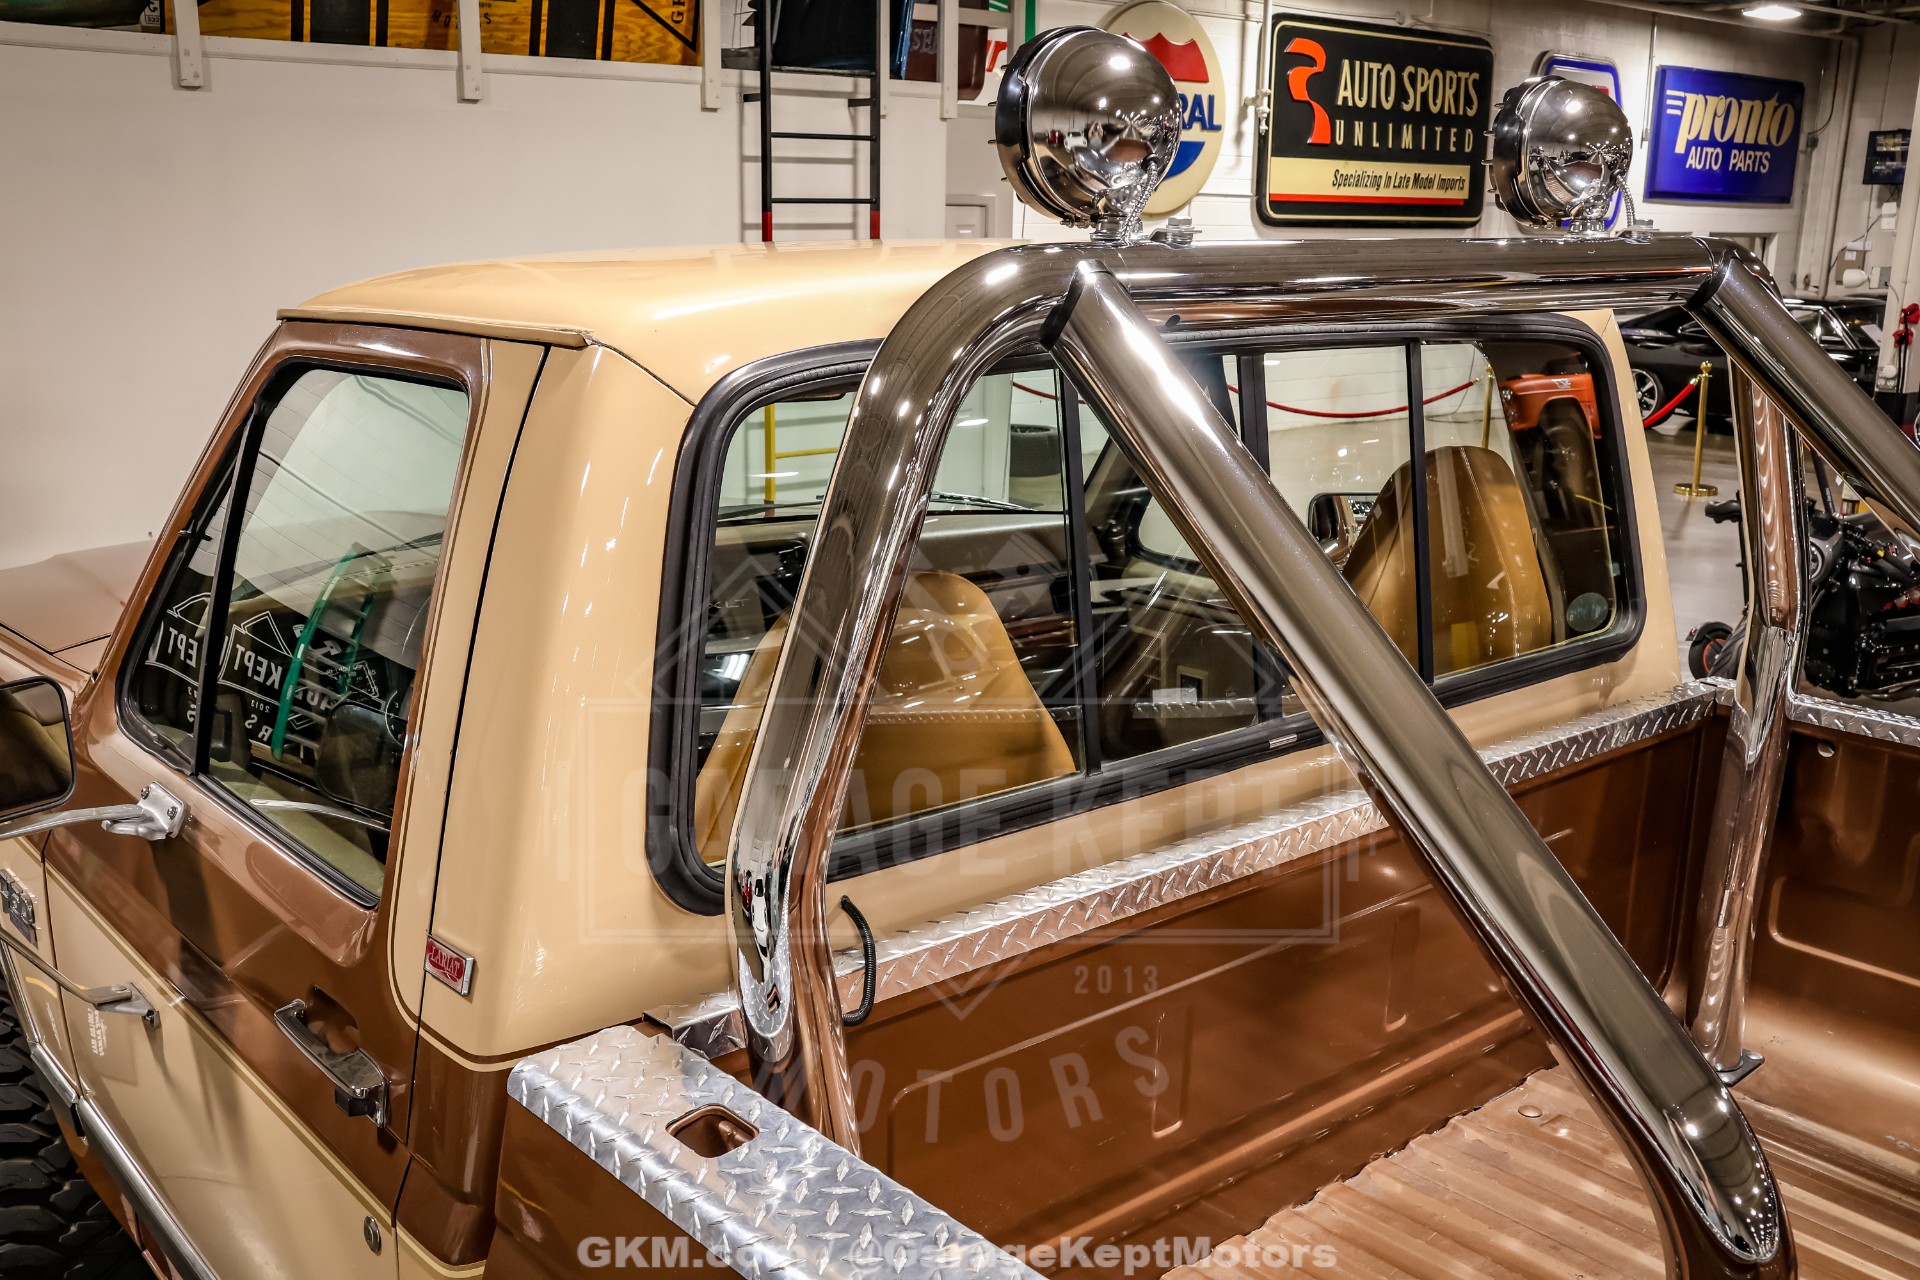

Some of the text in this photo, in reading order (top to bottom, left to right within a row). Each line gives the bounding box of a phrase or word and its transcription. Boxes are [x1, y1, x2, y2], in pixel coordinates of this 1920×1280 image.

[431, 9, 492, 29] MOS
[1337, 58, 1480, 118] AUTO SPORTS
[1335, 119, 1474, 153] UNLIMITED
[1674, 91, 1795, 154] pronto
[1685, 146, 1771, 173] AUTO PARTS
[1332, 168, 1383, 191] Specializing
[1393, 172, 1410, 189] Late
[1411, 172, 1435, 190] Model
[1436, 174, 1466, 193] Imports
[430, 945, 461, 977] LARIAT
